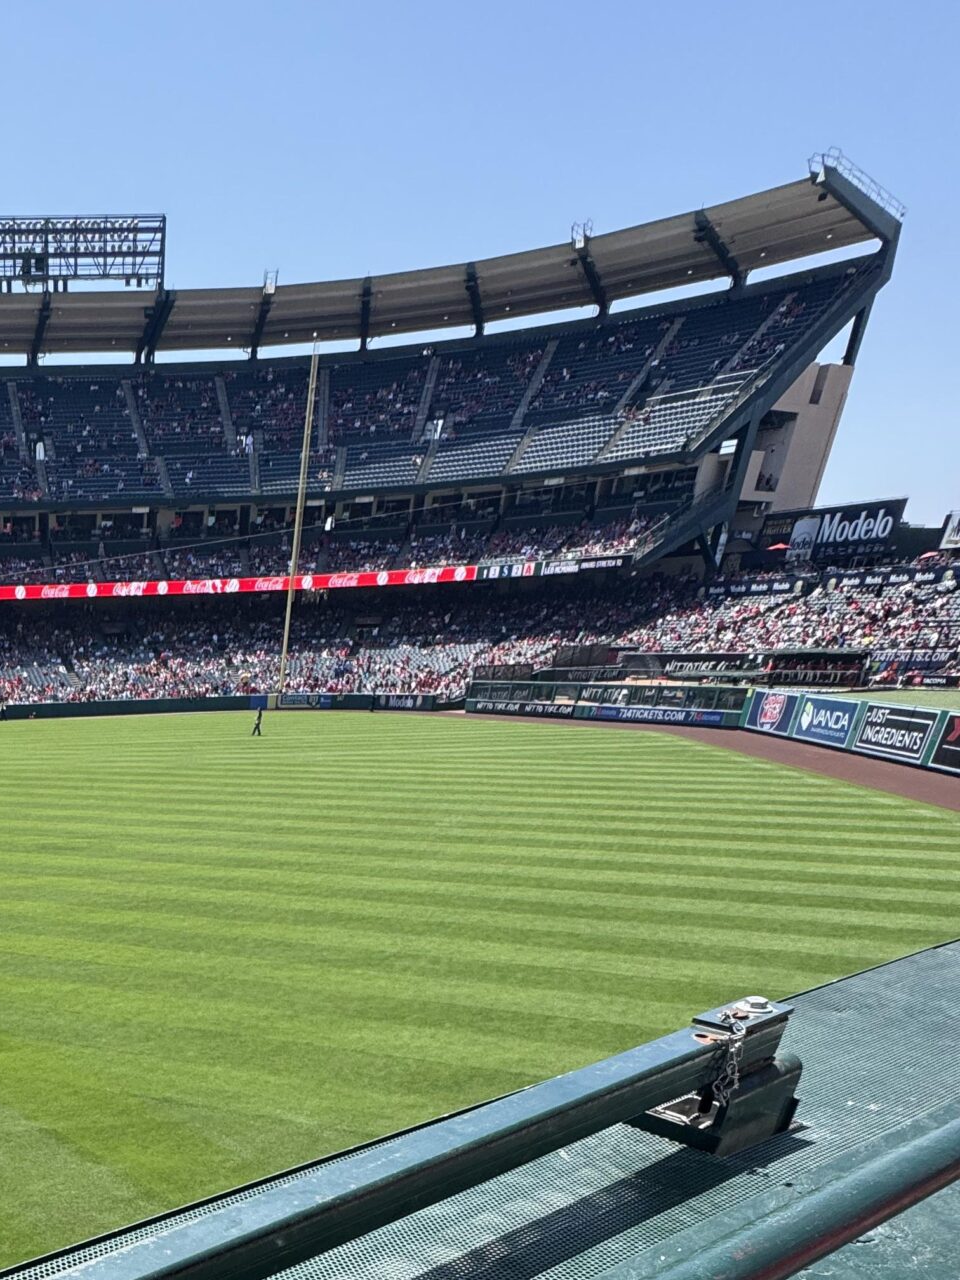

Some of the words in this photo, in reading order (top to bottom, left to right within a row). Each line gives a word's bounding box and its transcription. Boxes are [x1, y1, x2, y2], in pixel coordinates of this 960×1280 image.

[816, 508, 893, 544] Modelo
[388, 695, 414, 708] Modelo
[619, 708, 686, 722] 714TICKETS.COM
[812, 707, 850, 731] VANDA
[867, 707, 889, 724] JUST
[862, 724, 924, 751] INGREDIENTS
